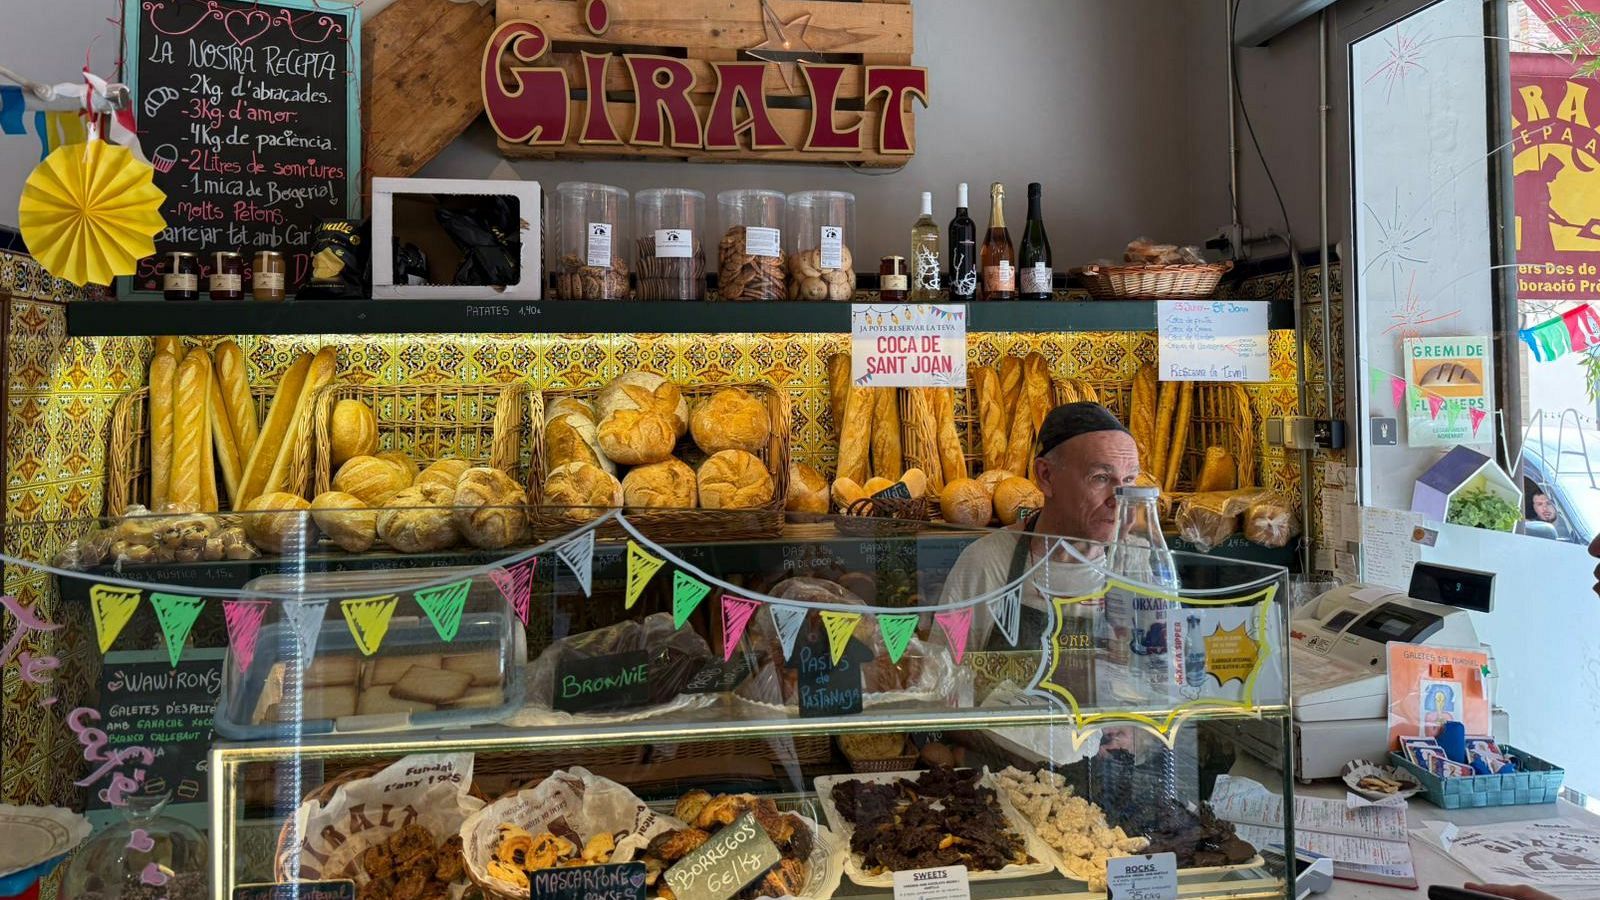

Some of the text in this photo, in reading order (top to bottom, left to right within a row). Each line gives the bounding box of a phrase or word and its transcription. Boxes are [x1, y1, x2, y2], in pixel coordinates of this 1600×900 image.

[149, 35, 174, 64] LA
[188, 38, 256, 73] NOSTRA
[481, 0, 928, 155] GIRALT
[226, 126, 249, 146] de
[204, 150, 242, 174] Litres
[246, 150, 267, 174] de
[204, 178, 244, 196] mica
[246, 180, 264, 197] de
[153, 224, 223, 249] arrejar
[229, 222, 250, 246] tot
[253, 227, 282, 246] amb
[1578, 262, 1597, 275] de
[466, 305, 509, 317] PATATES
[877, 335, 941, 353] COCA DE
[1413, 345, 1483, 357] GREMI DE
[866, 355, 953, 374] SANT JOAN
[109, 704, 160, 717] GALETES
[107, 721, 130, 731] AMB
[913, 870, 948, 880] SWEETS
[1125, 864, 1156, 873] ROCKS
